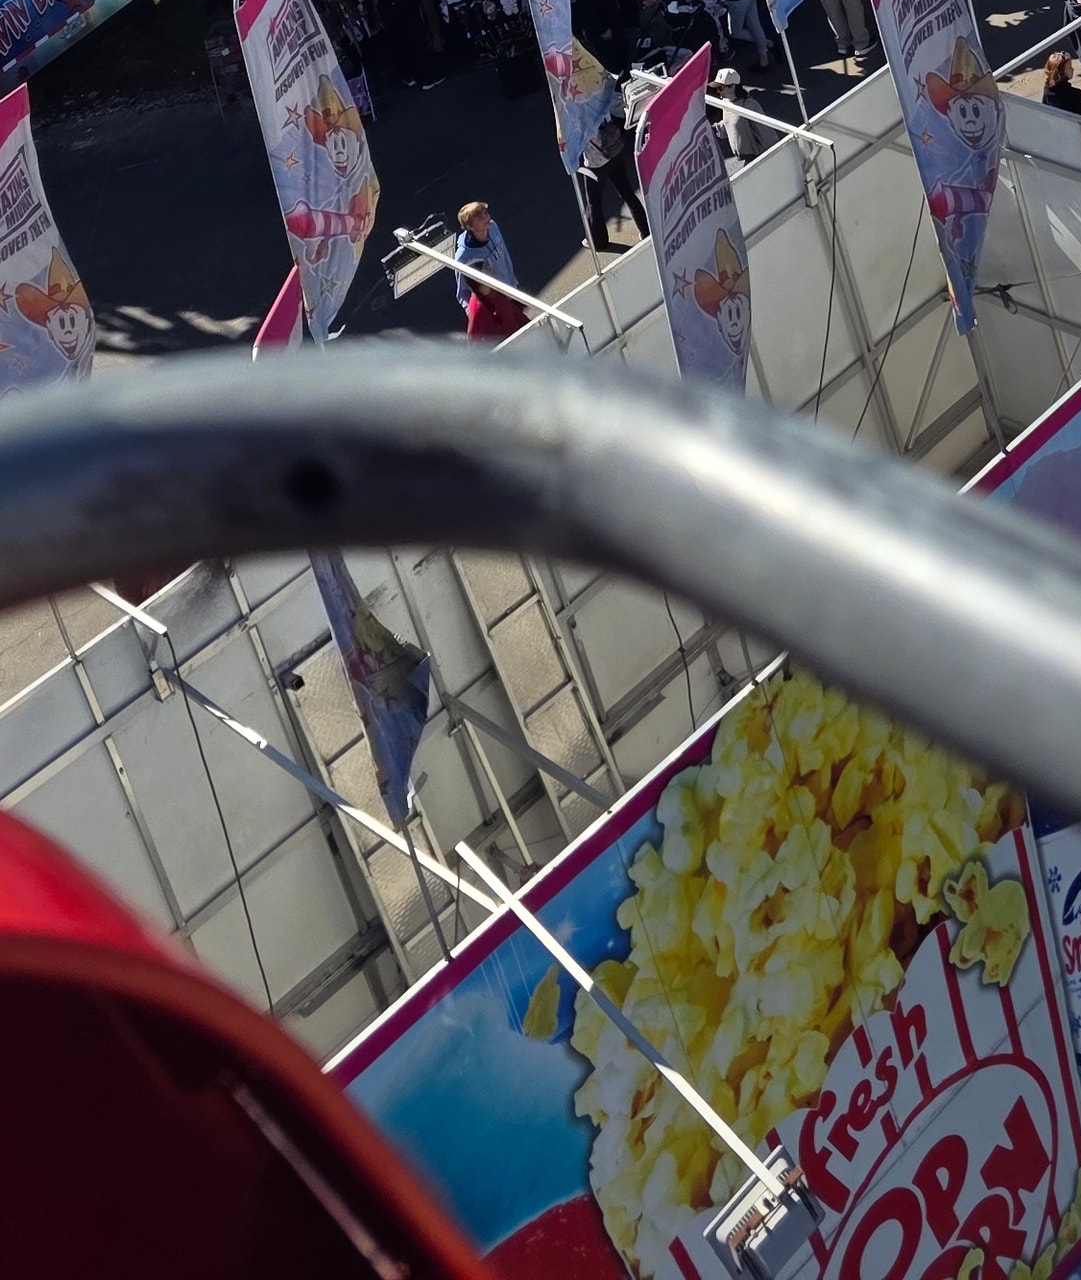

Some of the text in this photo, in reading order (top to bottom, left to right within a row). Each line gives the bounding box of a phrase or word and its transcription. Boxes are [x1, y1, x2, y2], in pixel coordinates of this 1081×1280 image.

[310, 38, 329, 62] FUN
[0, 167, 30, 218] AZING
[663, 134, 715, 222] AMAZING
[695, 199, 713, 223] THE
[712, 184, 733, 213] FUN
